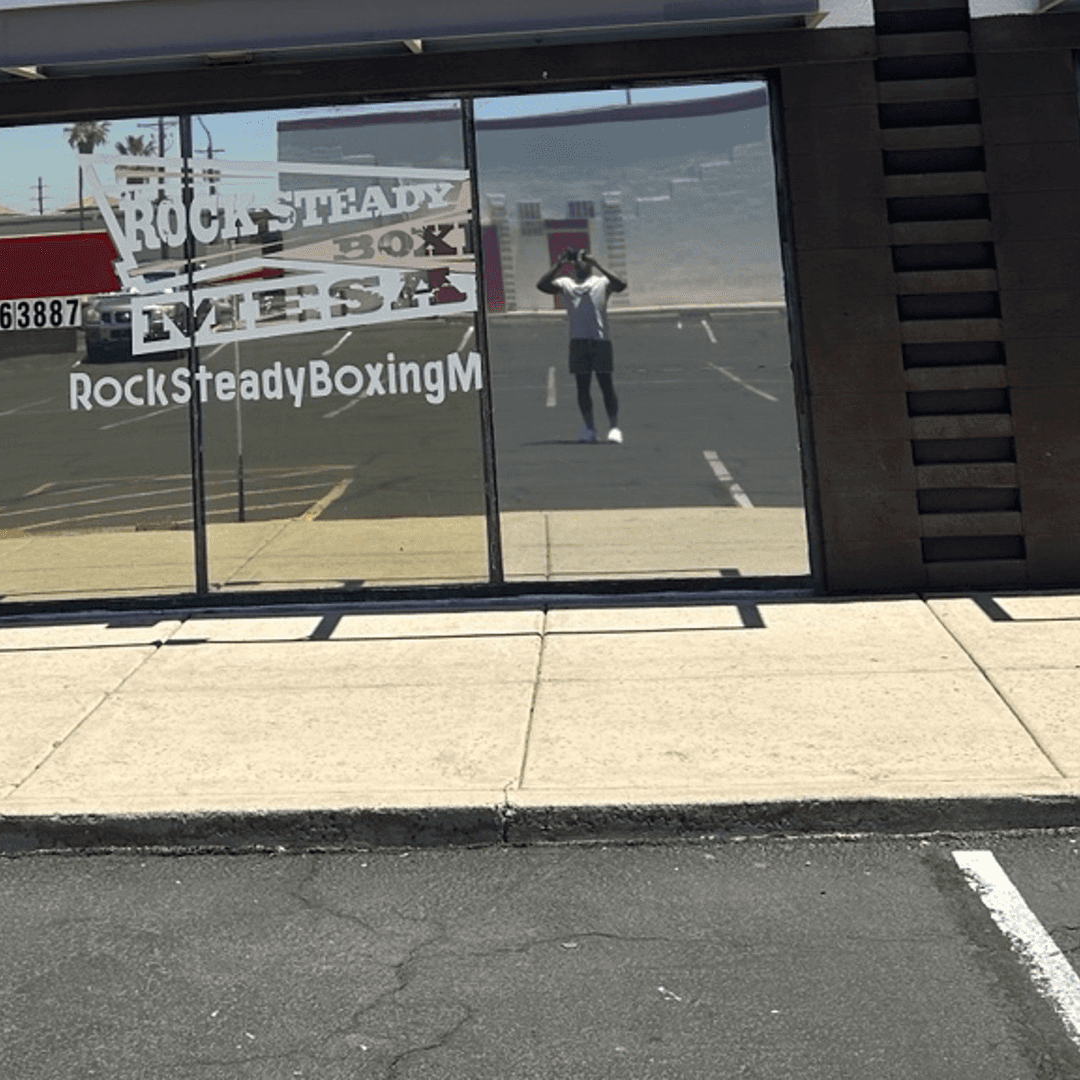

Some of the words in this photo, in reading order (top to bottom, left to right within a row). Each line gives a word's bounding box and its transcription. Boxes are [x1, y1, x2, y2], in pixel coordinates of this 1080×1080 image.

[120, 189, 258, 252] ROCK
[268, 181, 456, 232] STEADY
[142, 267, 468, 343] MESA
[69, 352, 483, 410] RockSteadyBoxingM
